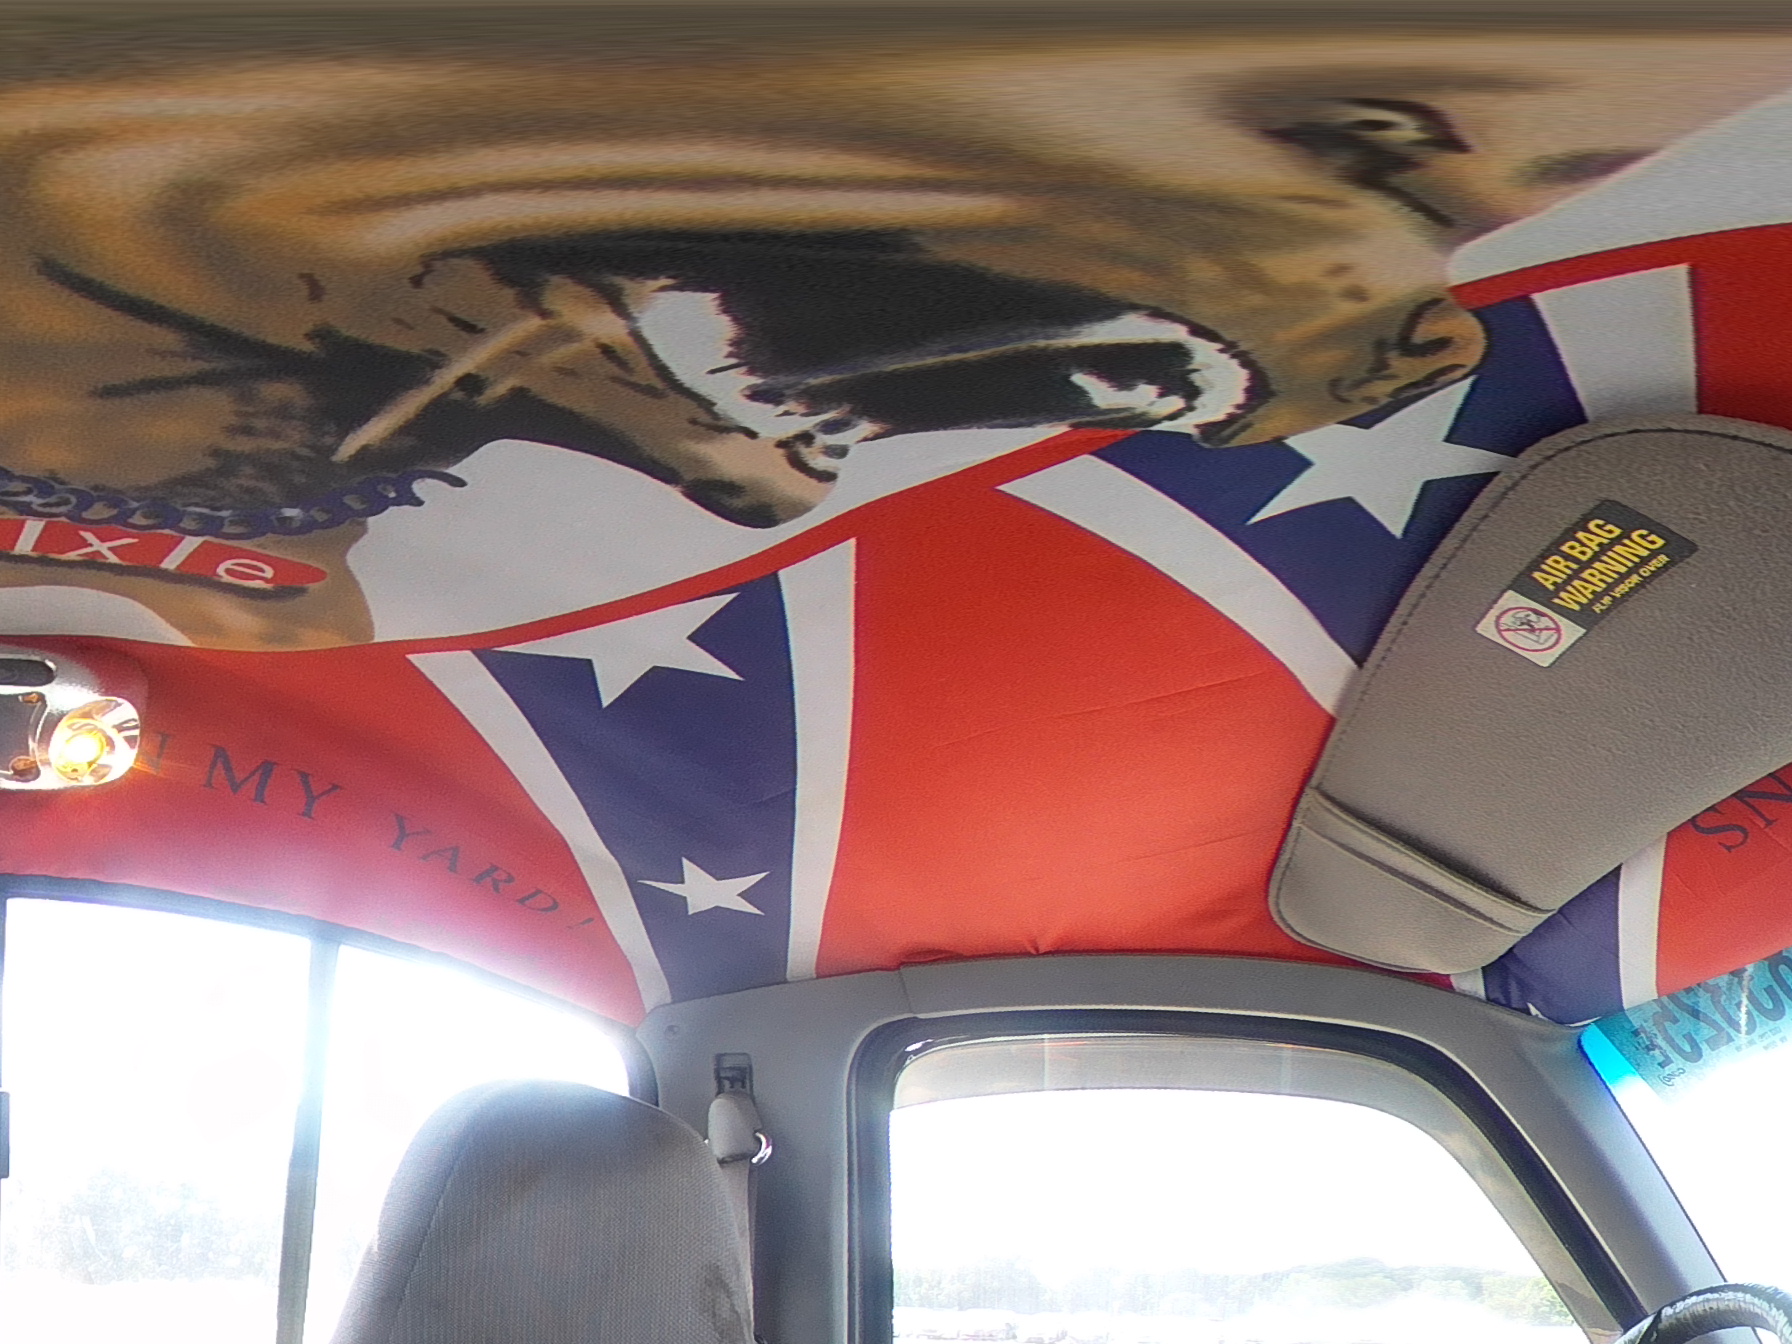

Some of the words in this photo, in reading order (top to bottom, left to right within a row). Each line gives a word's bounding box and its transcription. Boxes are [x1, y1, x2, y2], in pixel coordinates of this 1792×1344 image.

[1531, 555, 1580, 591] AIR
[1559, 518, 1623, 562] BAG
[1551, 529, 1667, 612] WARNING
[202, 744, 347, 821] MY
